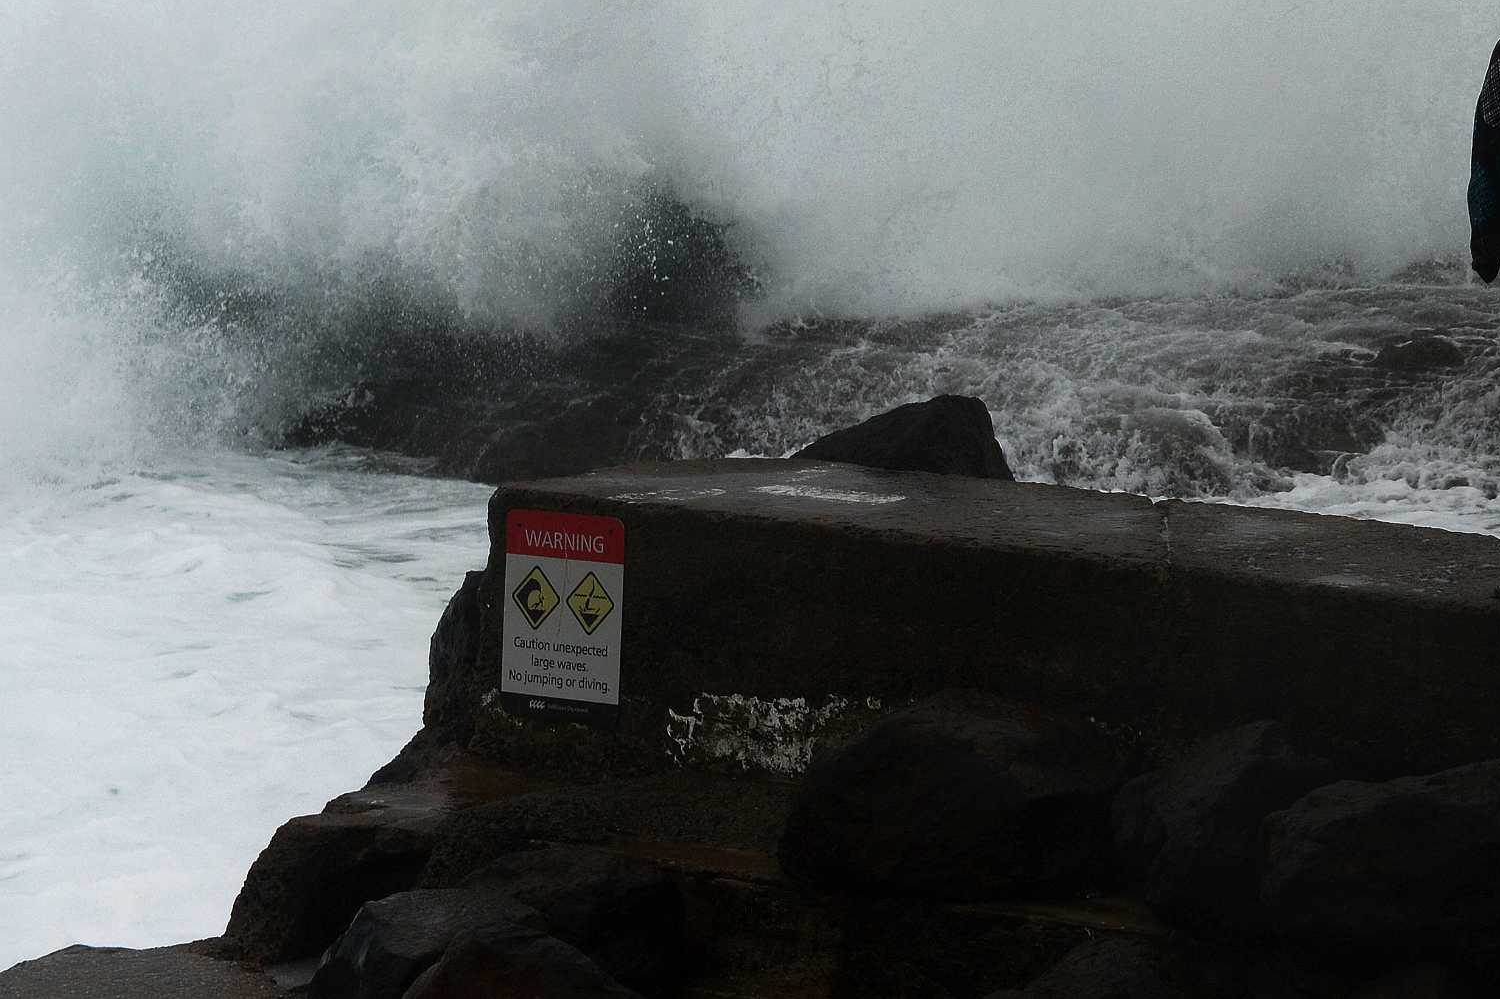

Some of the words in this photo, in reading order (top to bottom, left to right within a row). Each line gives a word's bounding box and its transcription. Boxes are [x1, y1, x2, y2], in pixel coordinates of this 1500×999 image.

[526, 529, 605, 553] WARNING
[513, 636, 550, 651] Caution
[553, 643, 608, 657] unexpected
[531, 654, 555, 670] large
[557, 661, 589, 672] waves.
[509, 669, 522, 681] No
[524, 672, 563, 689] jumping
[566, 678, 577, 688] or
[579, 677, 610, 694] diving.
